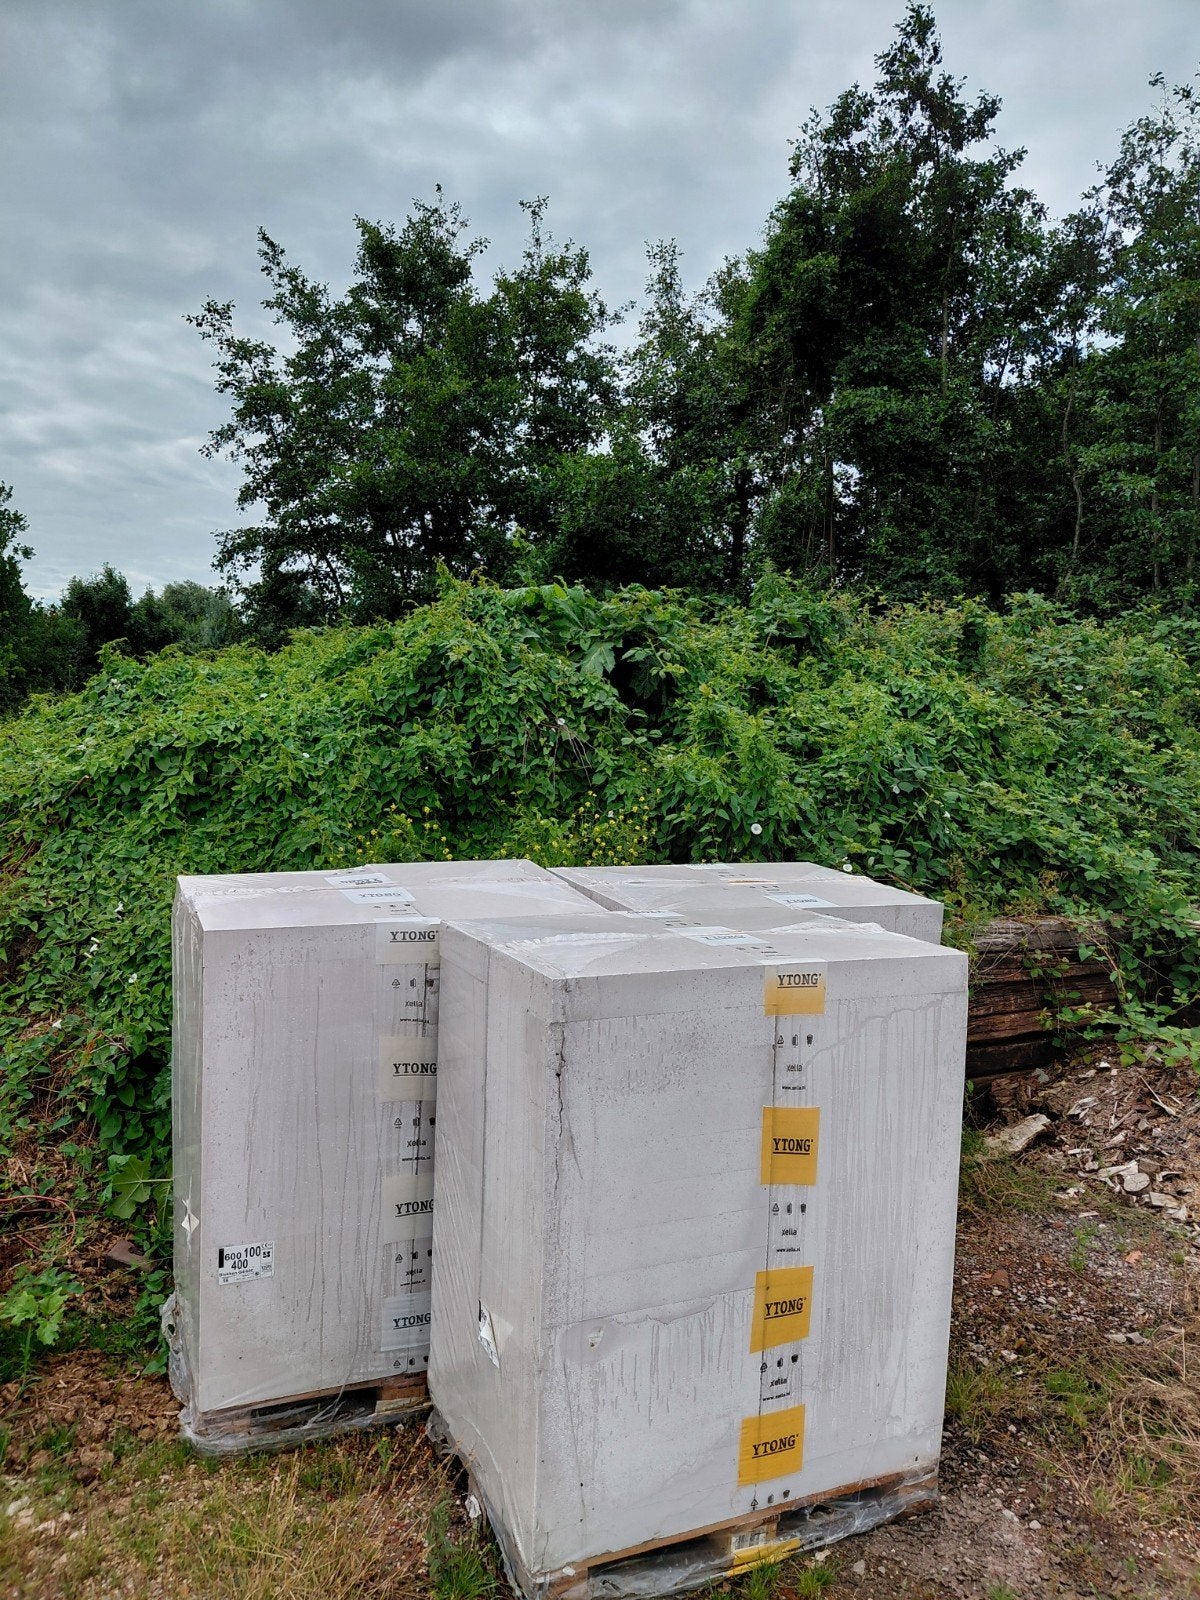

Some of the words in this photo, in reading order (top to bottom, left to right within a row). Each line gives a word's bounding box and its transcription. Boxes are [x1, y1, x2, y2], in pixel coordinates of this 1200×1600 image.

[390, 930, 436, 941] YTONG
[777, 973, 819, 986] YTONG
[392, 1062, 437, 1074] YTONG
[772, 1138, 811, 1152] YTONG
[225, 1251, 242, 1261] 600
[244, 1245, 261, 1259] 100
[231, 1258, 249, 1270] 400
[765, 1297, 804, 1317] YTONG
[393, 1312, 431, 1328] YTONG
[752, 1434, 797, 1456] YTONG
